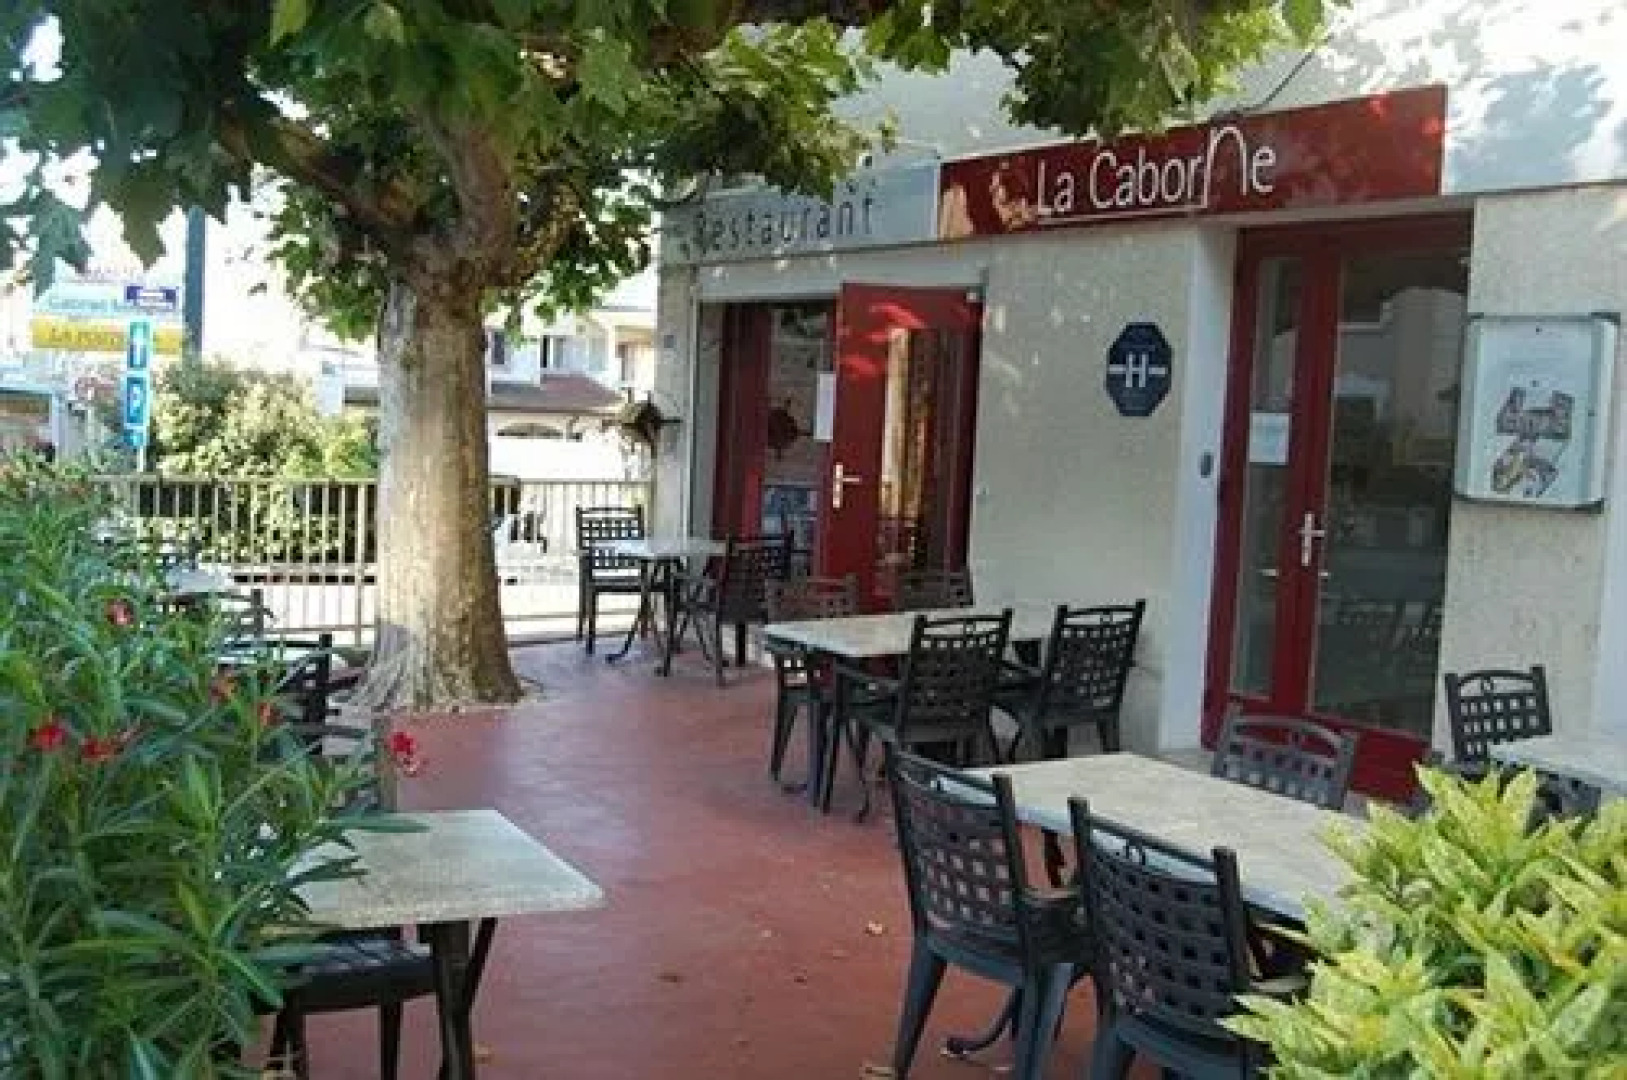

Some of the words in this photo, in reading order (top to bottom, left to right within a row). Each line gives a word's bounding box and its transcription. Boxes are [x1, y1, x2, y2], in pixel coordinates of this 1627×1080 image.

[1037, 158, 1075, 216] La
[694, 196, 875, 254] Restaurant
[1125, 352, 1148, 388] H
